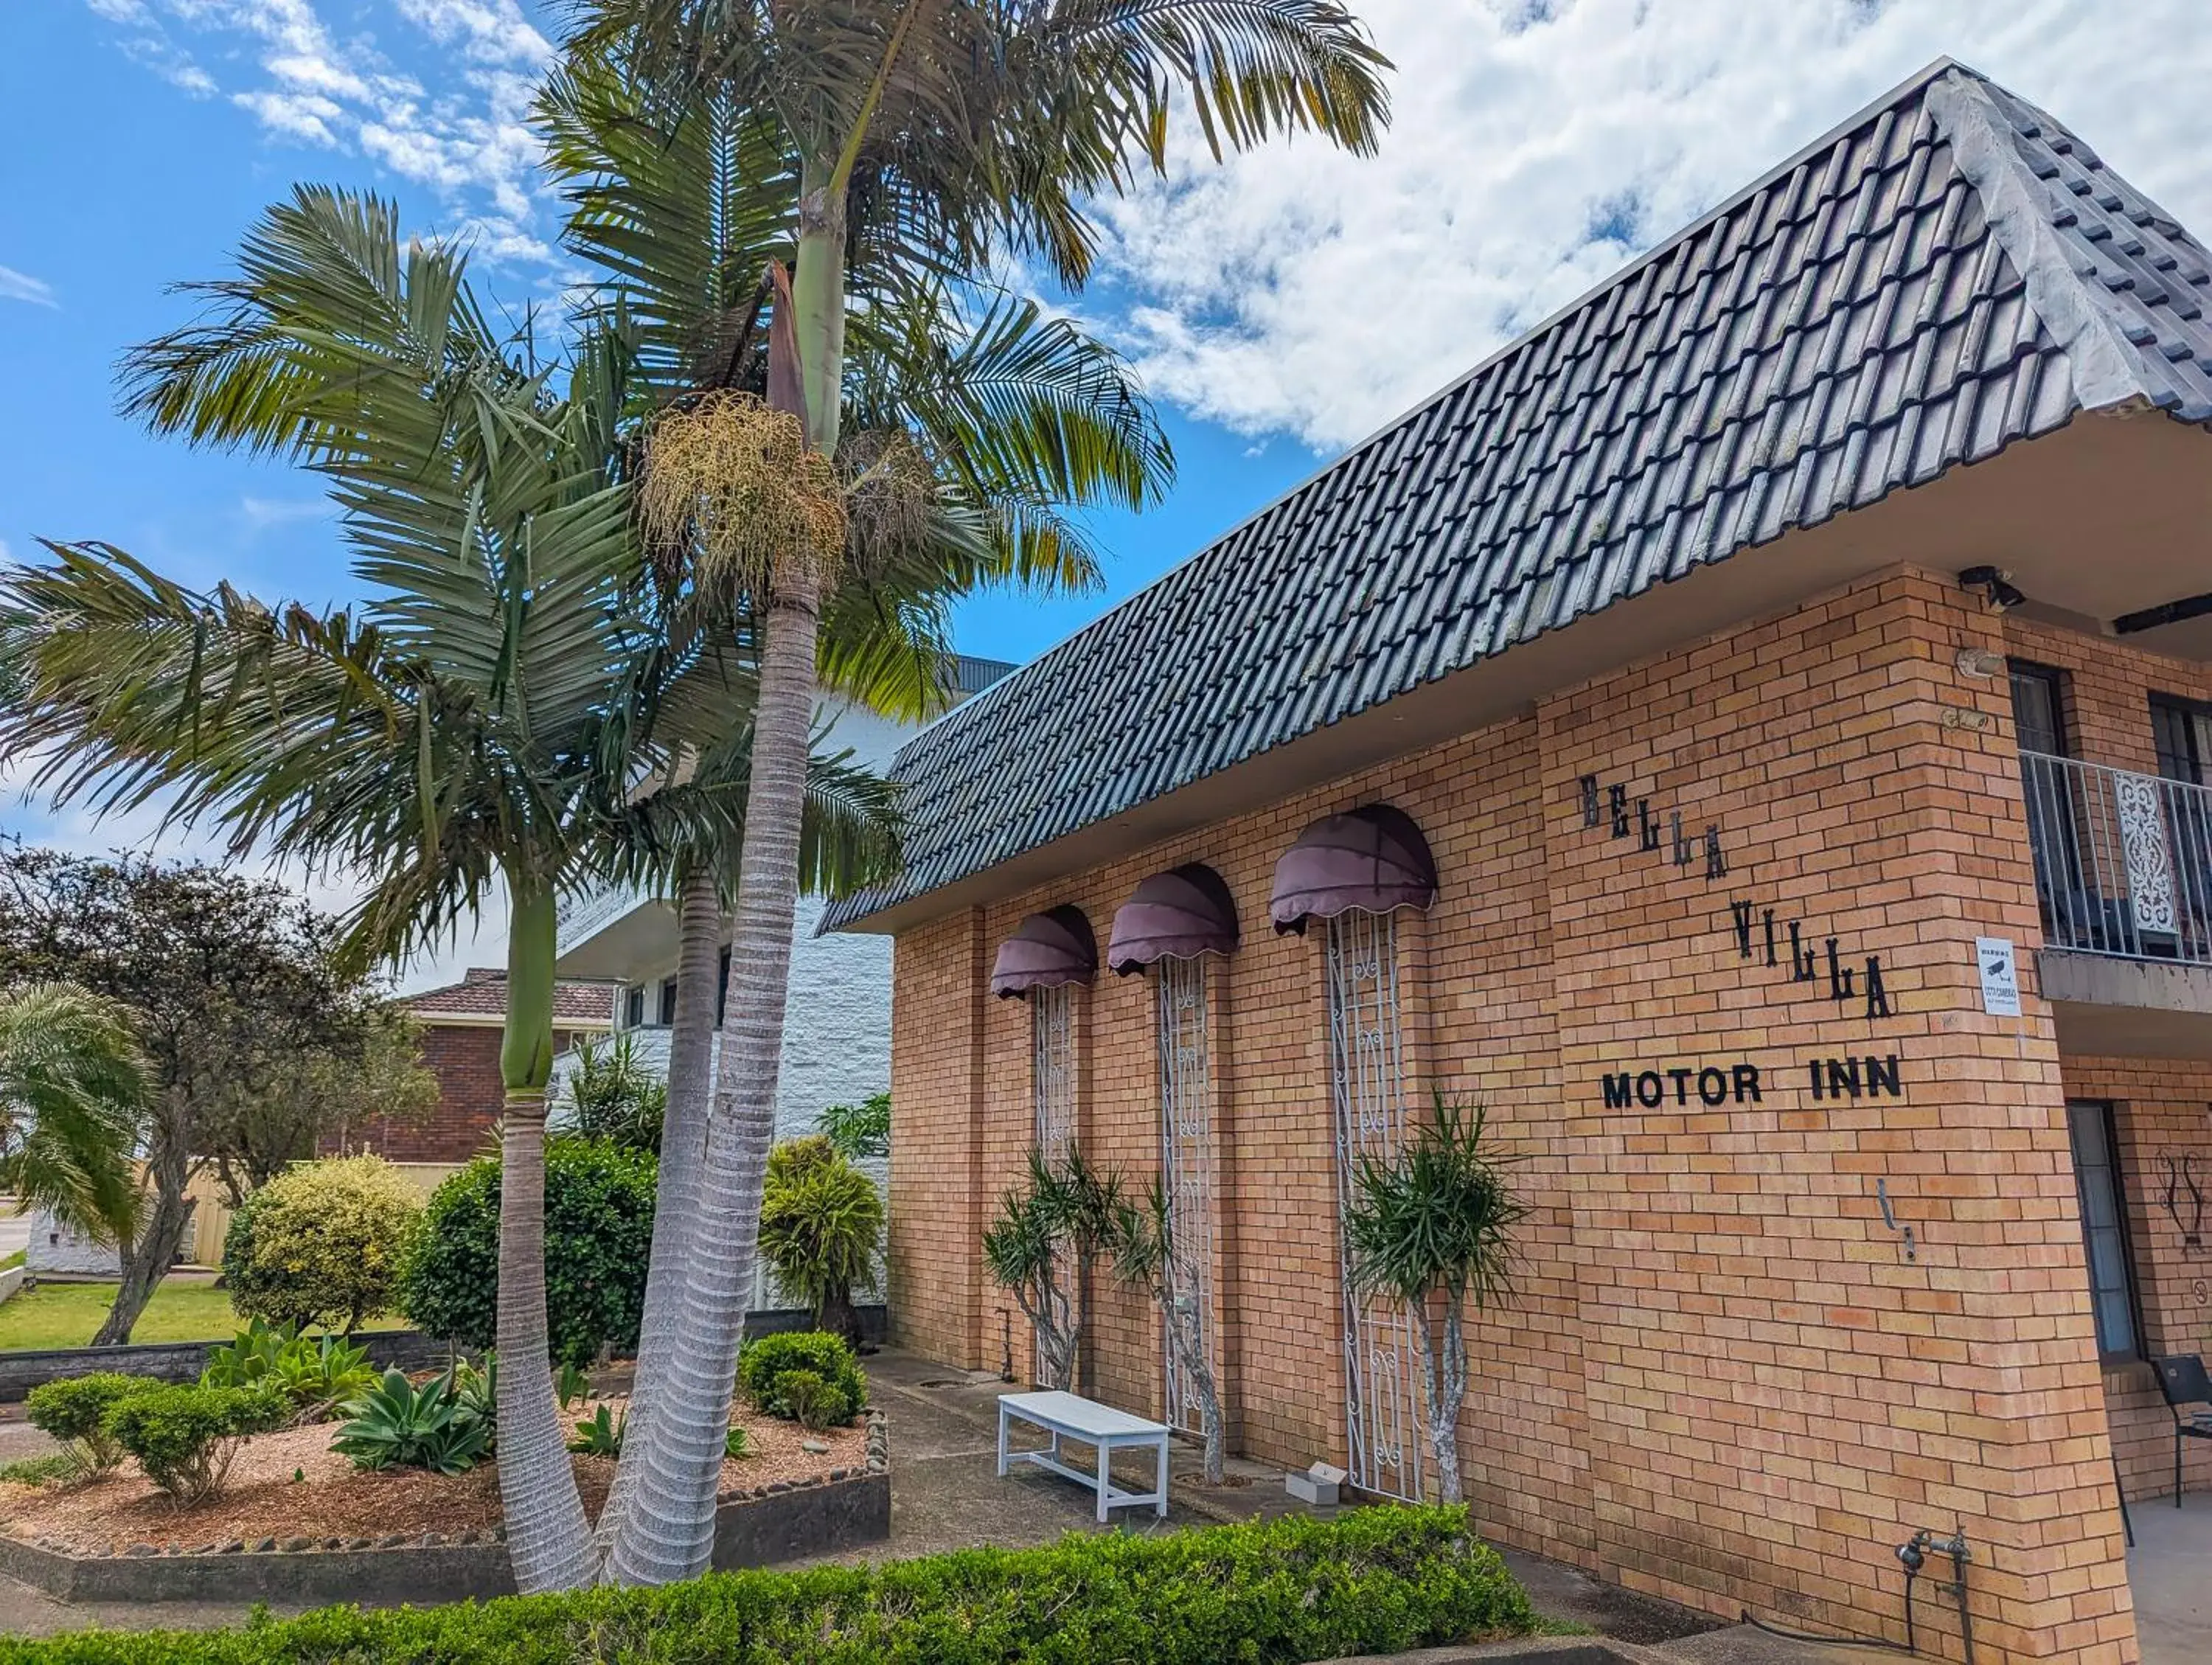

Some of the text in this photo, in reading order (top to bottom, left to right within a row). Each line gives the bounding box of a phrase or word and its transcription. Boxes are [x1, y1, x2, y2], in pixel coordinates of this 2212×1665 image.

[1580, 775, 1891, 1018] BELLA VILLA
[1602, 1054, 1901, 1108] MOTOR INN
